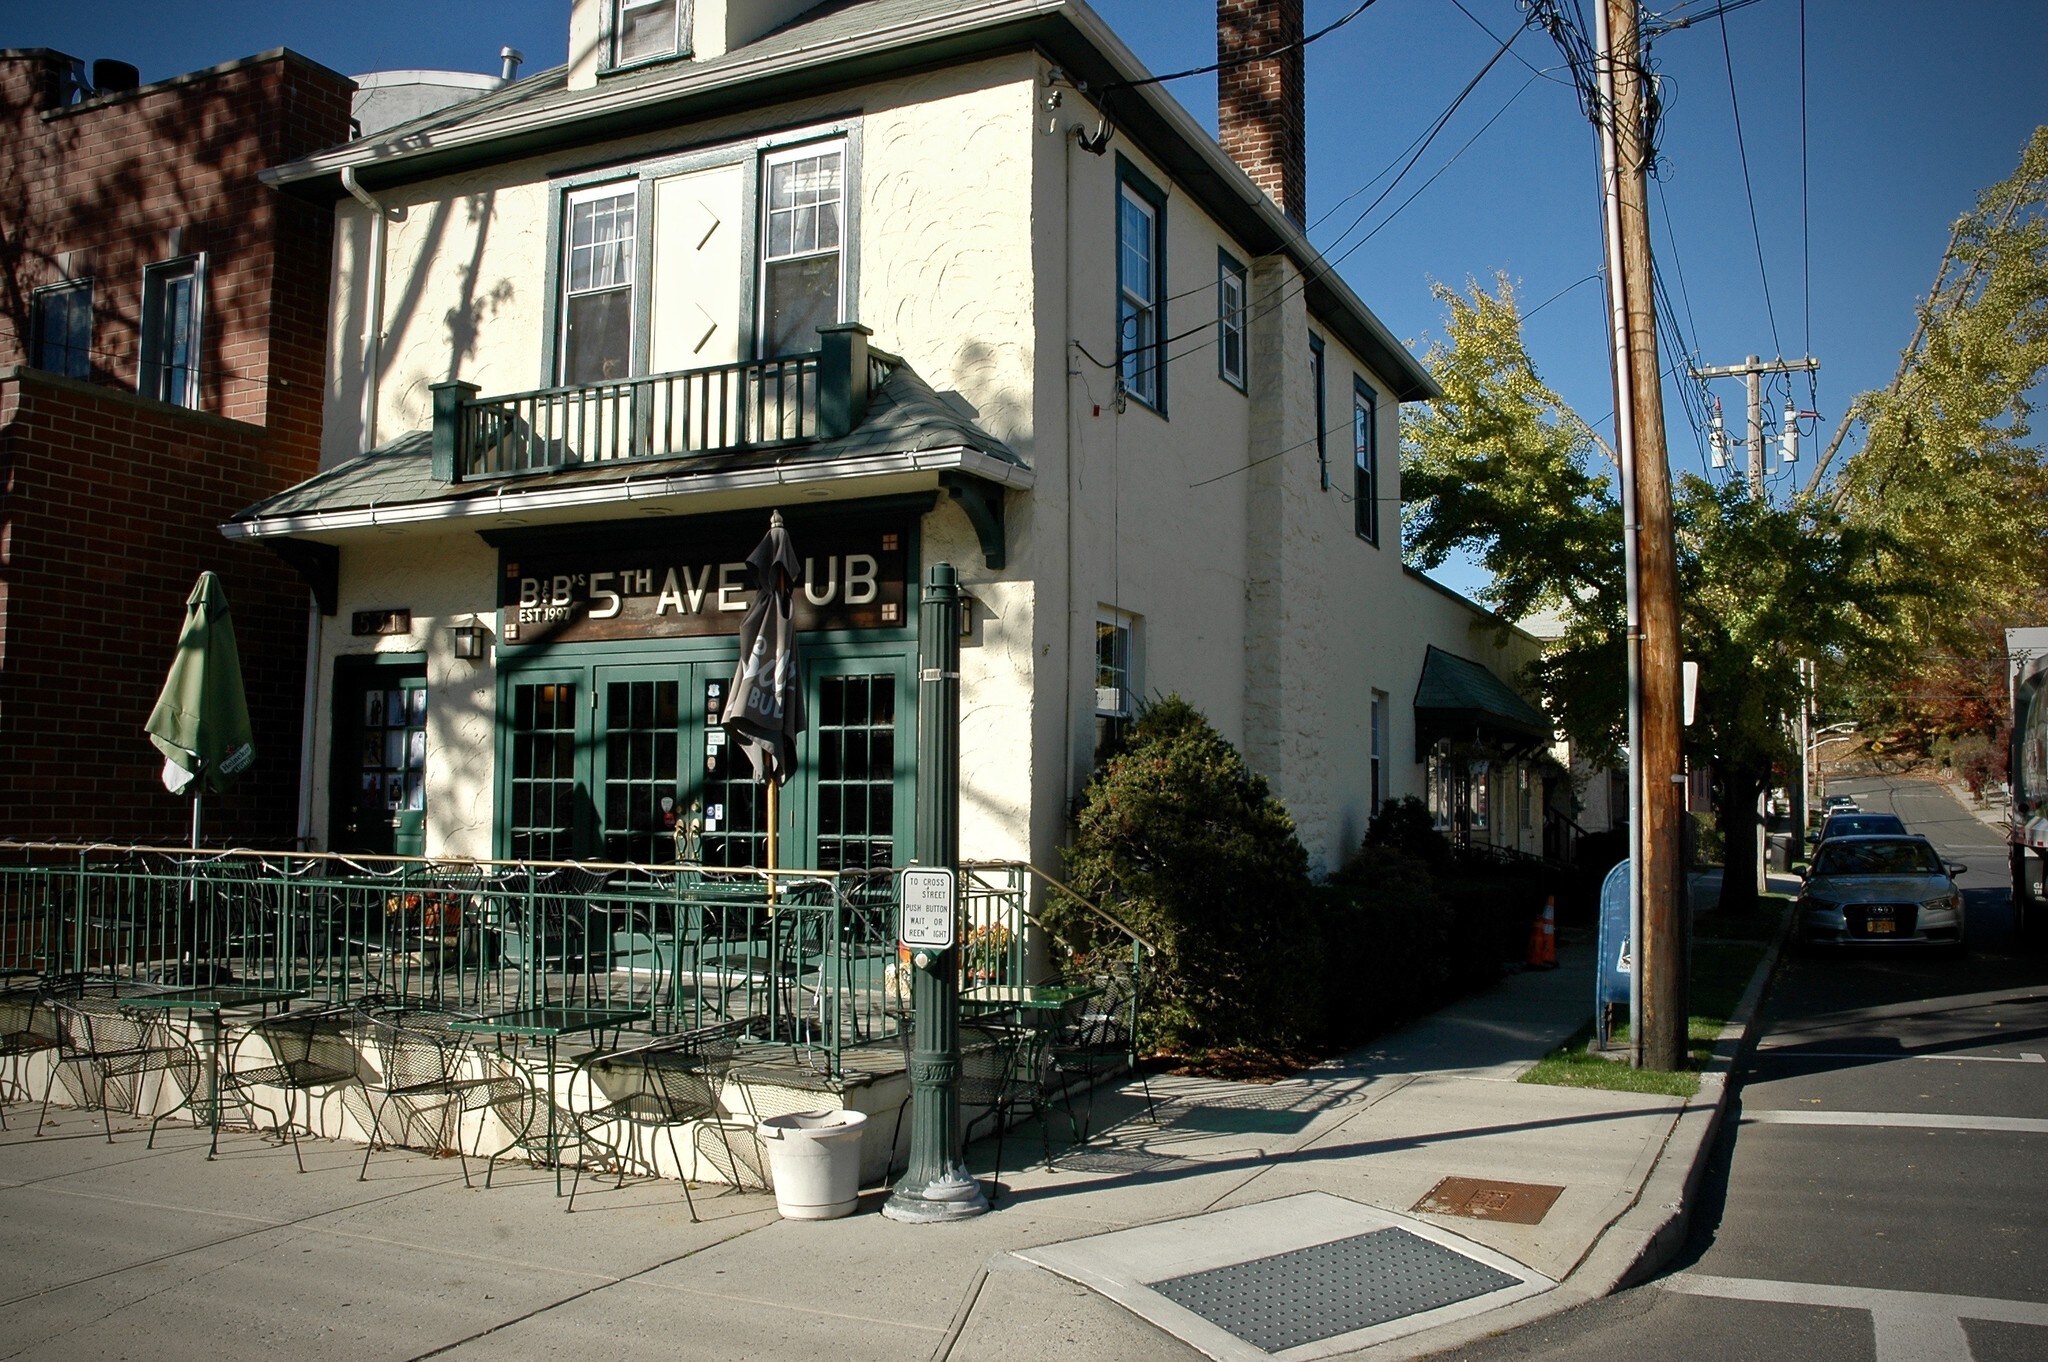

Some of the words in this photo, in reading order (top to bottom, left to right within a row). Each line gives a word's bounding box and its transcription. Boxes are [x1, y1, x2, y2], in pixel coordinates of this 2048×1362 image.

[656, 563, 750, 616] AVE
[804, 554, 879, 606] UB
[519, 607, 542, 622] EST
[544, 606, 571, 621] 1997
[910, 878, 918, 886] TO
[923, 878, 944, 886] CROSS
